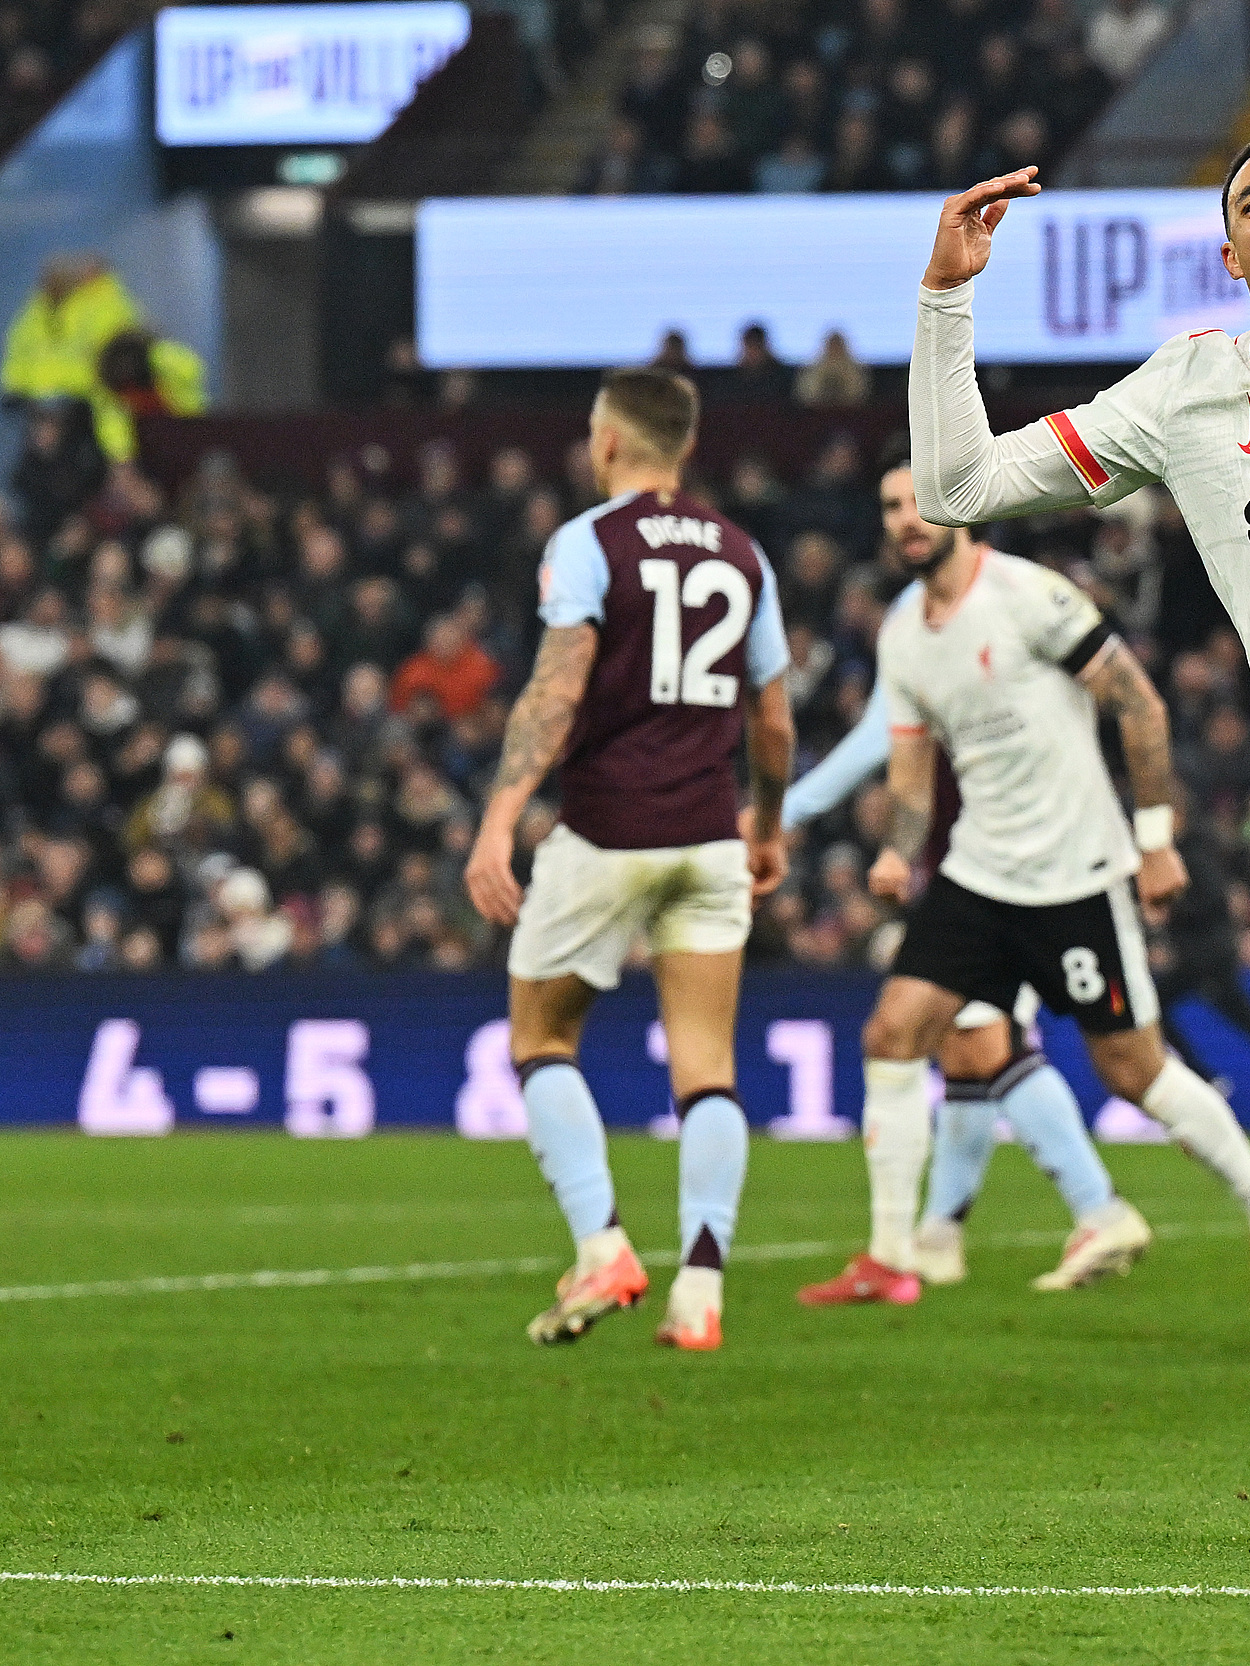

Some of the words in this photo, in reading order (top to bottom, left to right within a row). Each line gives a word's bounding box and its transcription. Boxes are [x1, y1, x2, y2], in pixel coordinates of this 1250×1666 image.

[1042, 215, 1148, 334] UP
[638, 558, 751, 708] 12
[1060, 946, 1107, 1005] 8
